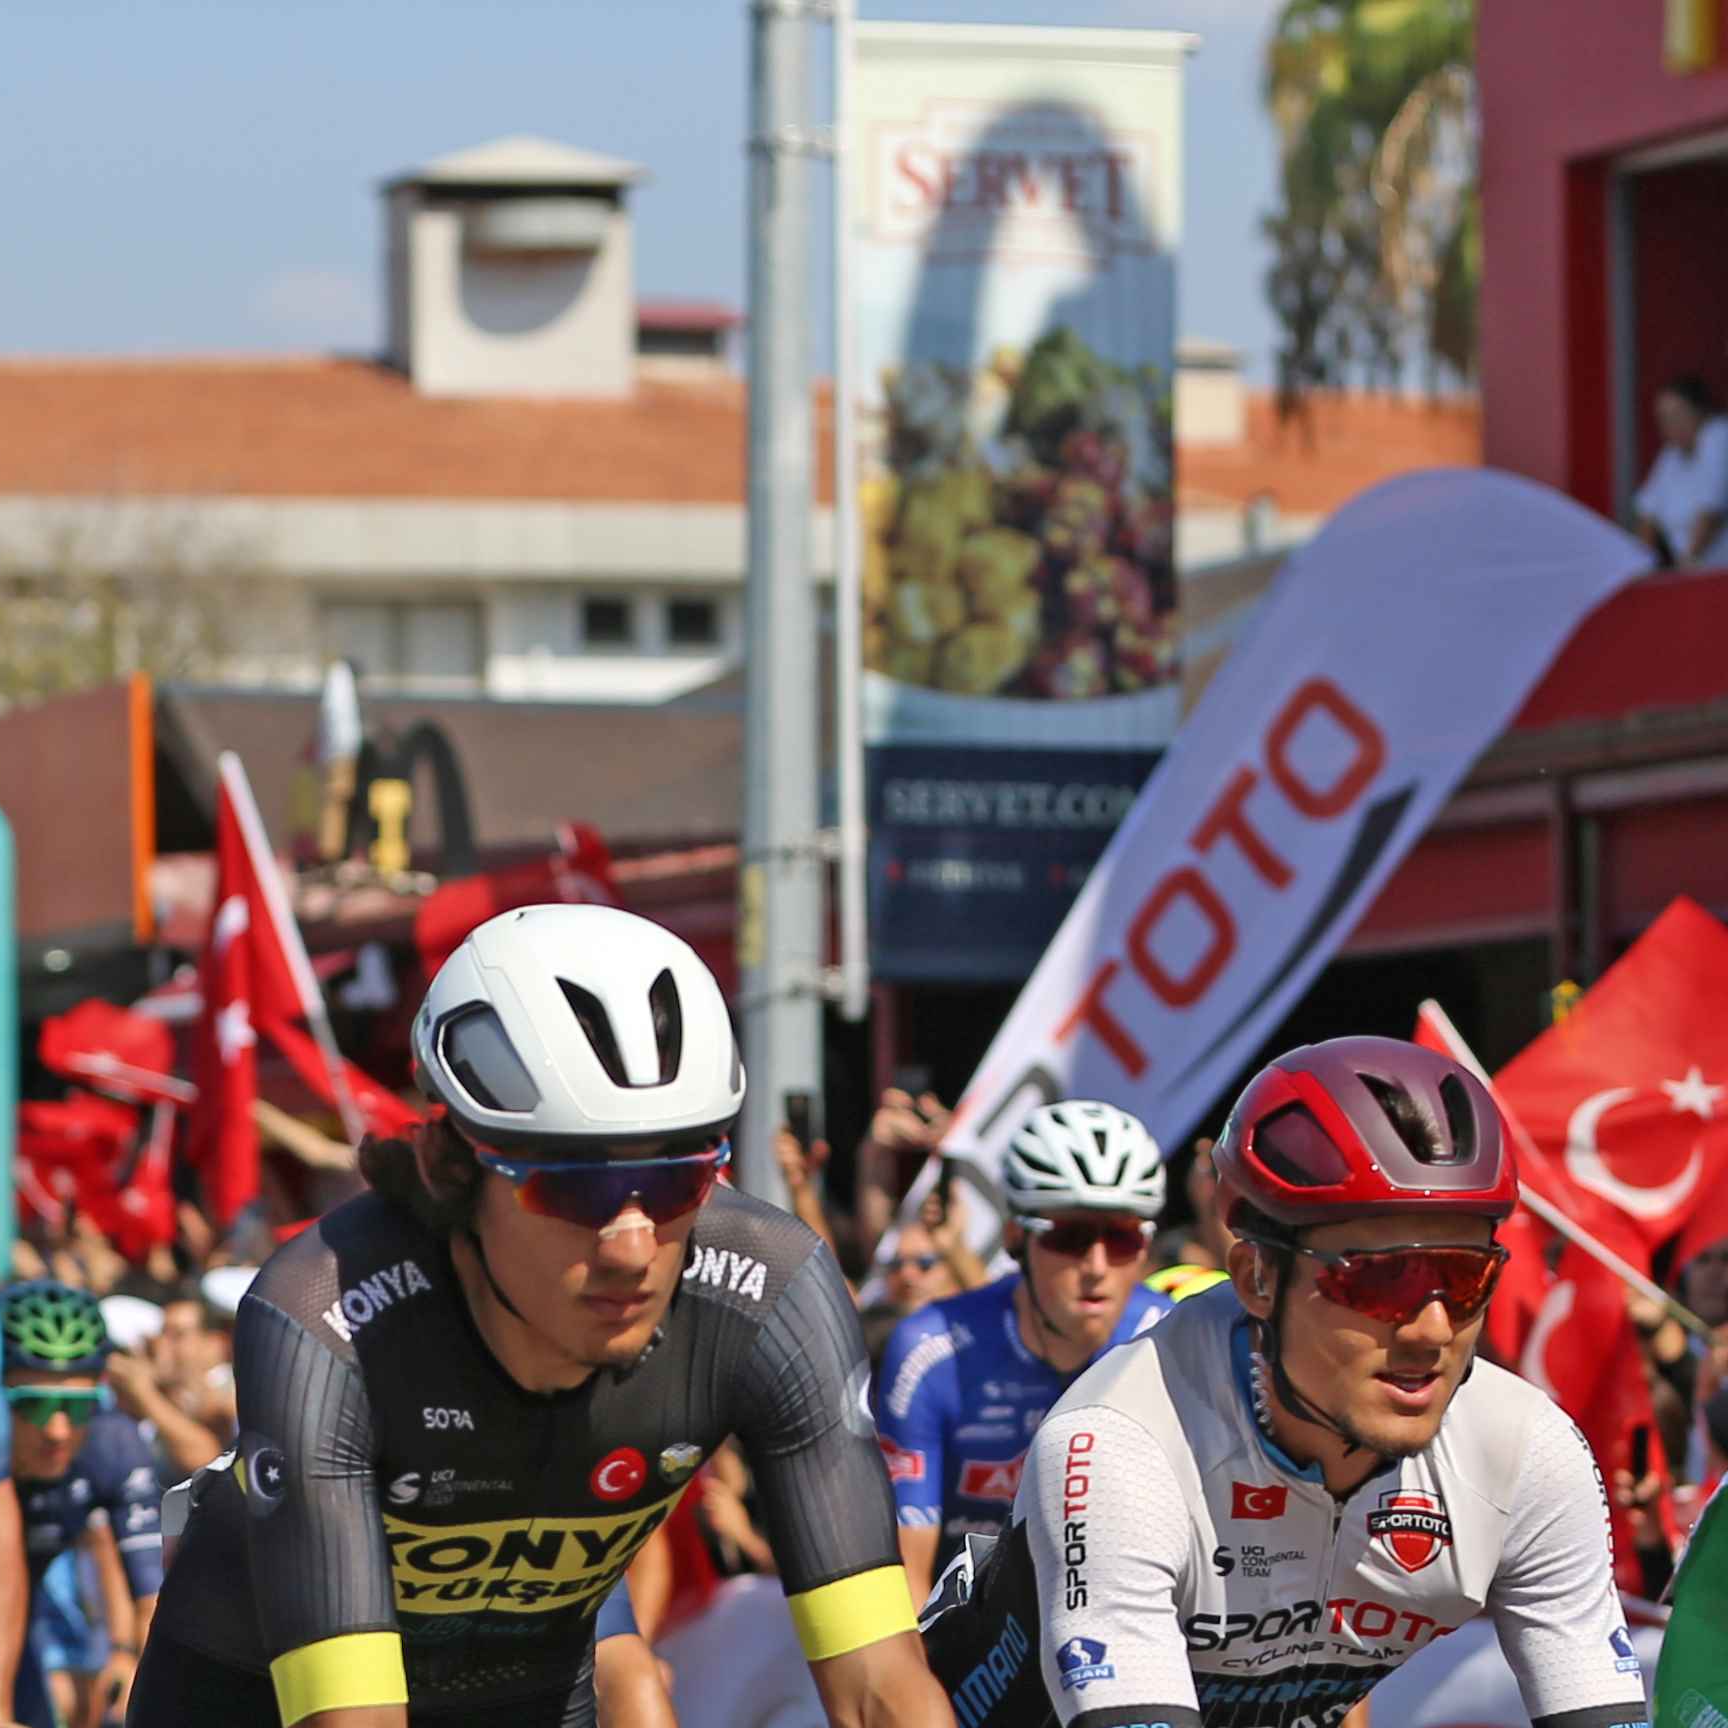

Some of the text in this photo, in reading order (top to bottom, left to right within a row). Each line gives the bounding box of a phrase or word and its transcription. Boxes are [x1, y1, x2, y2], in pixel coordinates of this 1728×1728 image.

[894, 146, 1133, 225] SERVET
[321, 1259, 433, 1343] KONYA
[423, 1407, 474, 1431] SORA
[1063, 1430, 1095, 1611] SPORTOTO
[1241, 1546, 1266, 1556] UCI
[1241, 1567, 1272, 1578] TEAM
[1221, 1641, 1326, 1669] CYCLING
